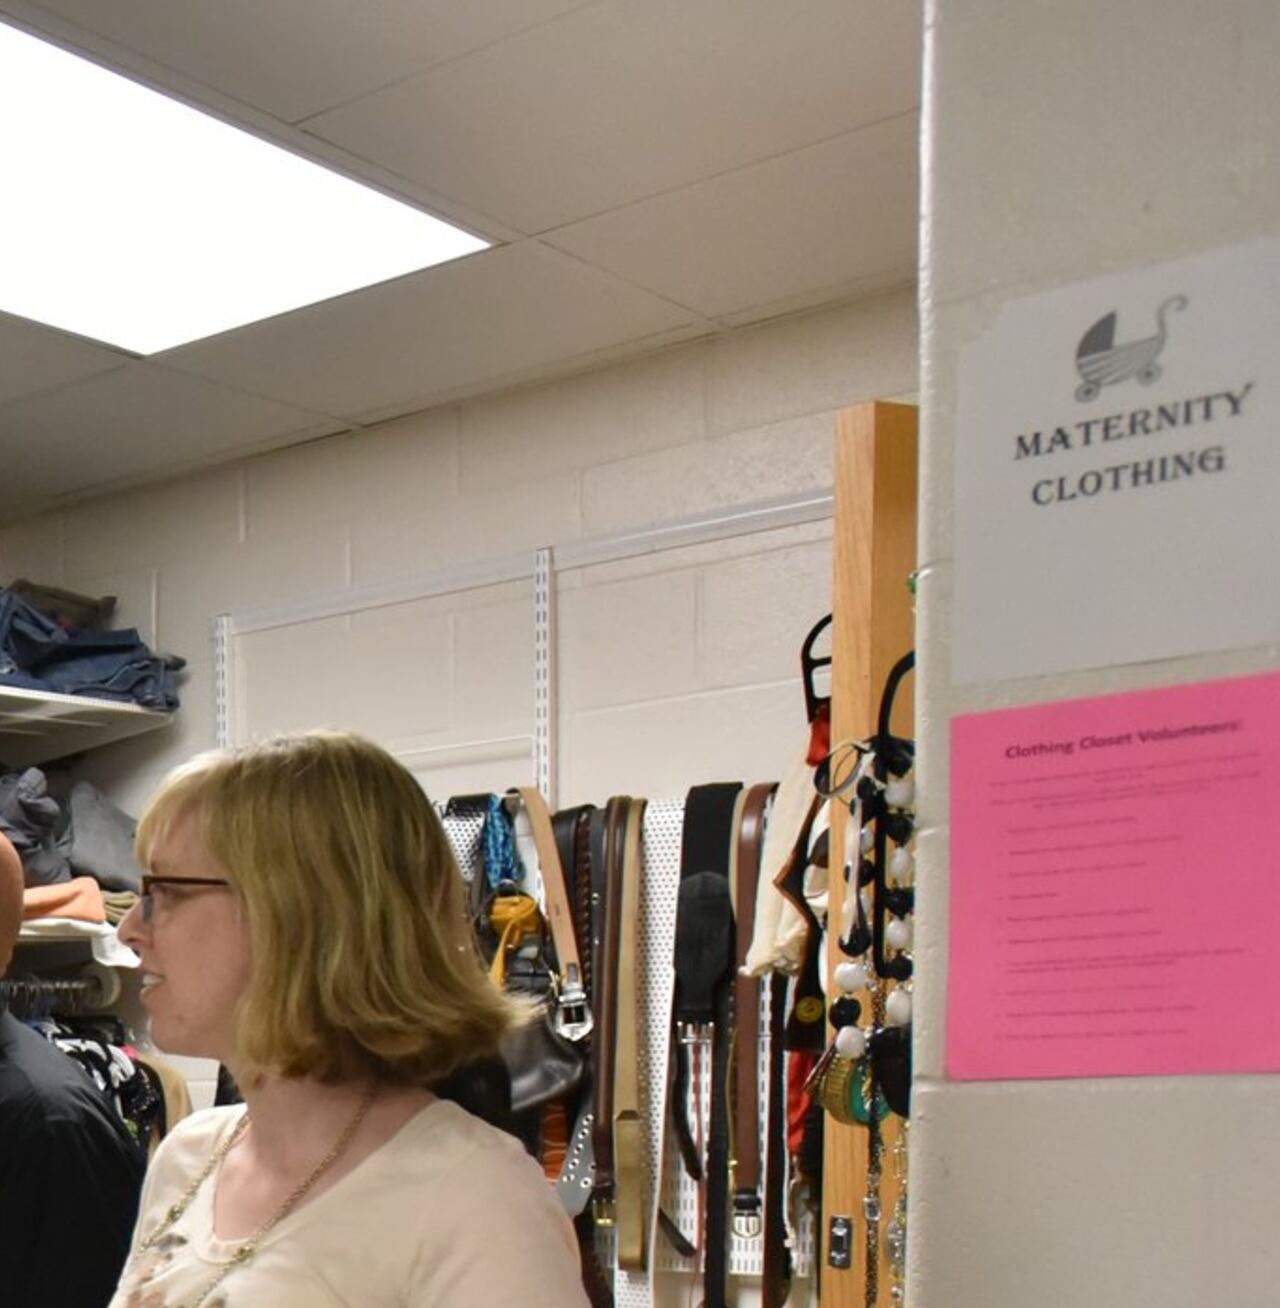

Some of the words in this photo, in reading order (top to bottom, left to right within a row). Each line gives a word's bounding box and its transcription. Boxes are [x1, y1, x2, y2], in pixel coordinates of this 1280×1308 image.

[1013, 382, 1256, 461] MATERNITY
[1031, 446, 1227, 507] CLOTHING
[1005, 741, 1075, 760] Clothing
[1080, 732, 1133, 751] Closet
